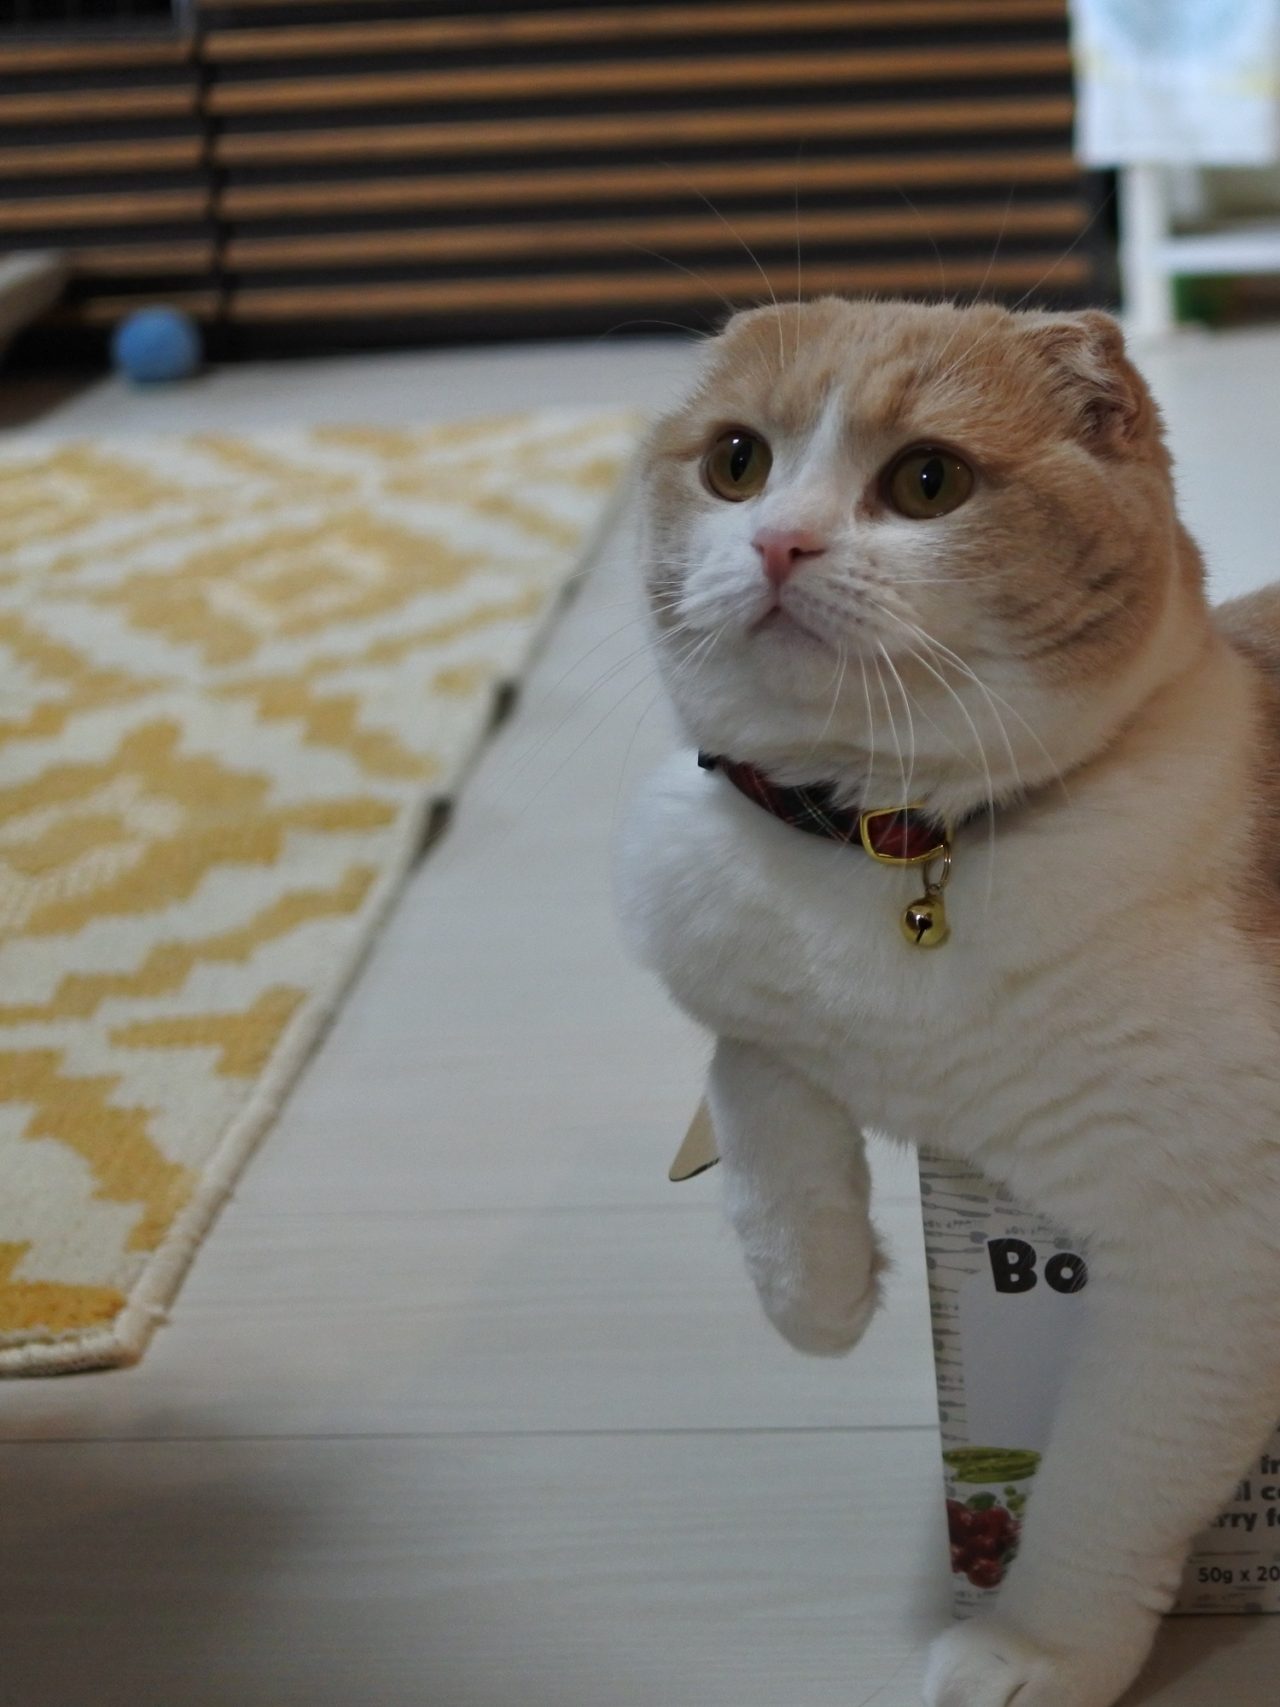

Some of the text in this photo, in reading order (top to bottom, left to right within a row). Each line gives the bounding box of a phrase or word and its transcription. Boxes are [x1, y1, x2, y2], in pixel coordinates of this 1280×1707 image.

[1210, 1512, 1258, 1533] rry
[1197, 1566, 1234, 1584] 50g
[1240, 1569, 1251, 1582] x
